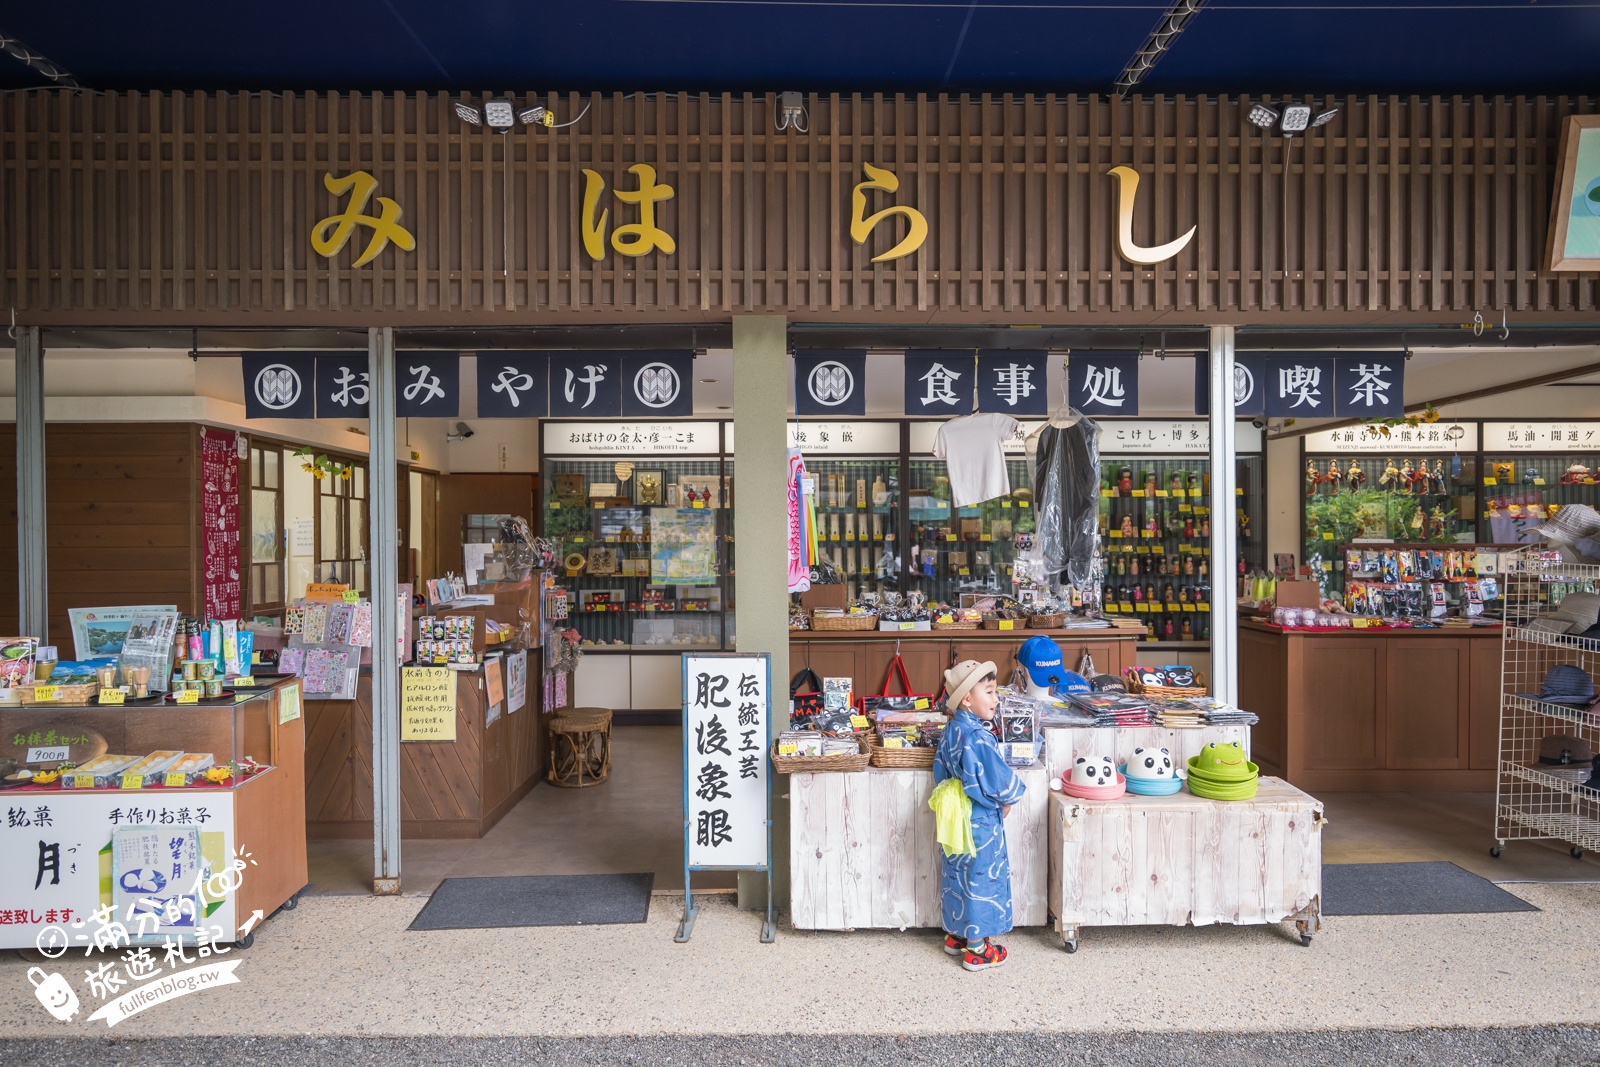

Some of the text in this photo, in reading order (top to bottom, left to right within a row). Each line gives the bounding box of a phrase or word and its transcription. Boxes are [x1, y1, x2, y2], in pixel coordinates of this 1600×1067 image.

[310, 162, 1197, 267] みはらし
[330, 364, 608, 409] おみやげ
[918, 362, 1126, 407] 食事処
[1279, 363, 1392, 409] 喫茶
[12, 729, 89, 746] お抹茶セット
[737, 672, 760, 779] 伝統工芸
[34, 750, 65, 760] 900円
[694, 672, 733, 848] 肥後象眼
[0, 805, 53, 828] 銘菓
[108, 806, 212, 825] 手作りお菓子
